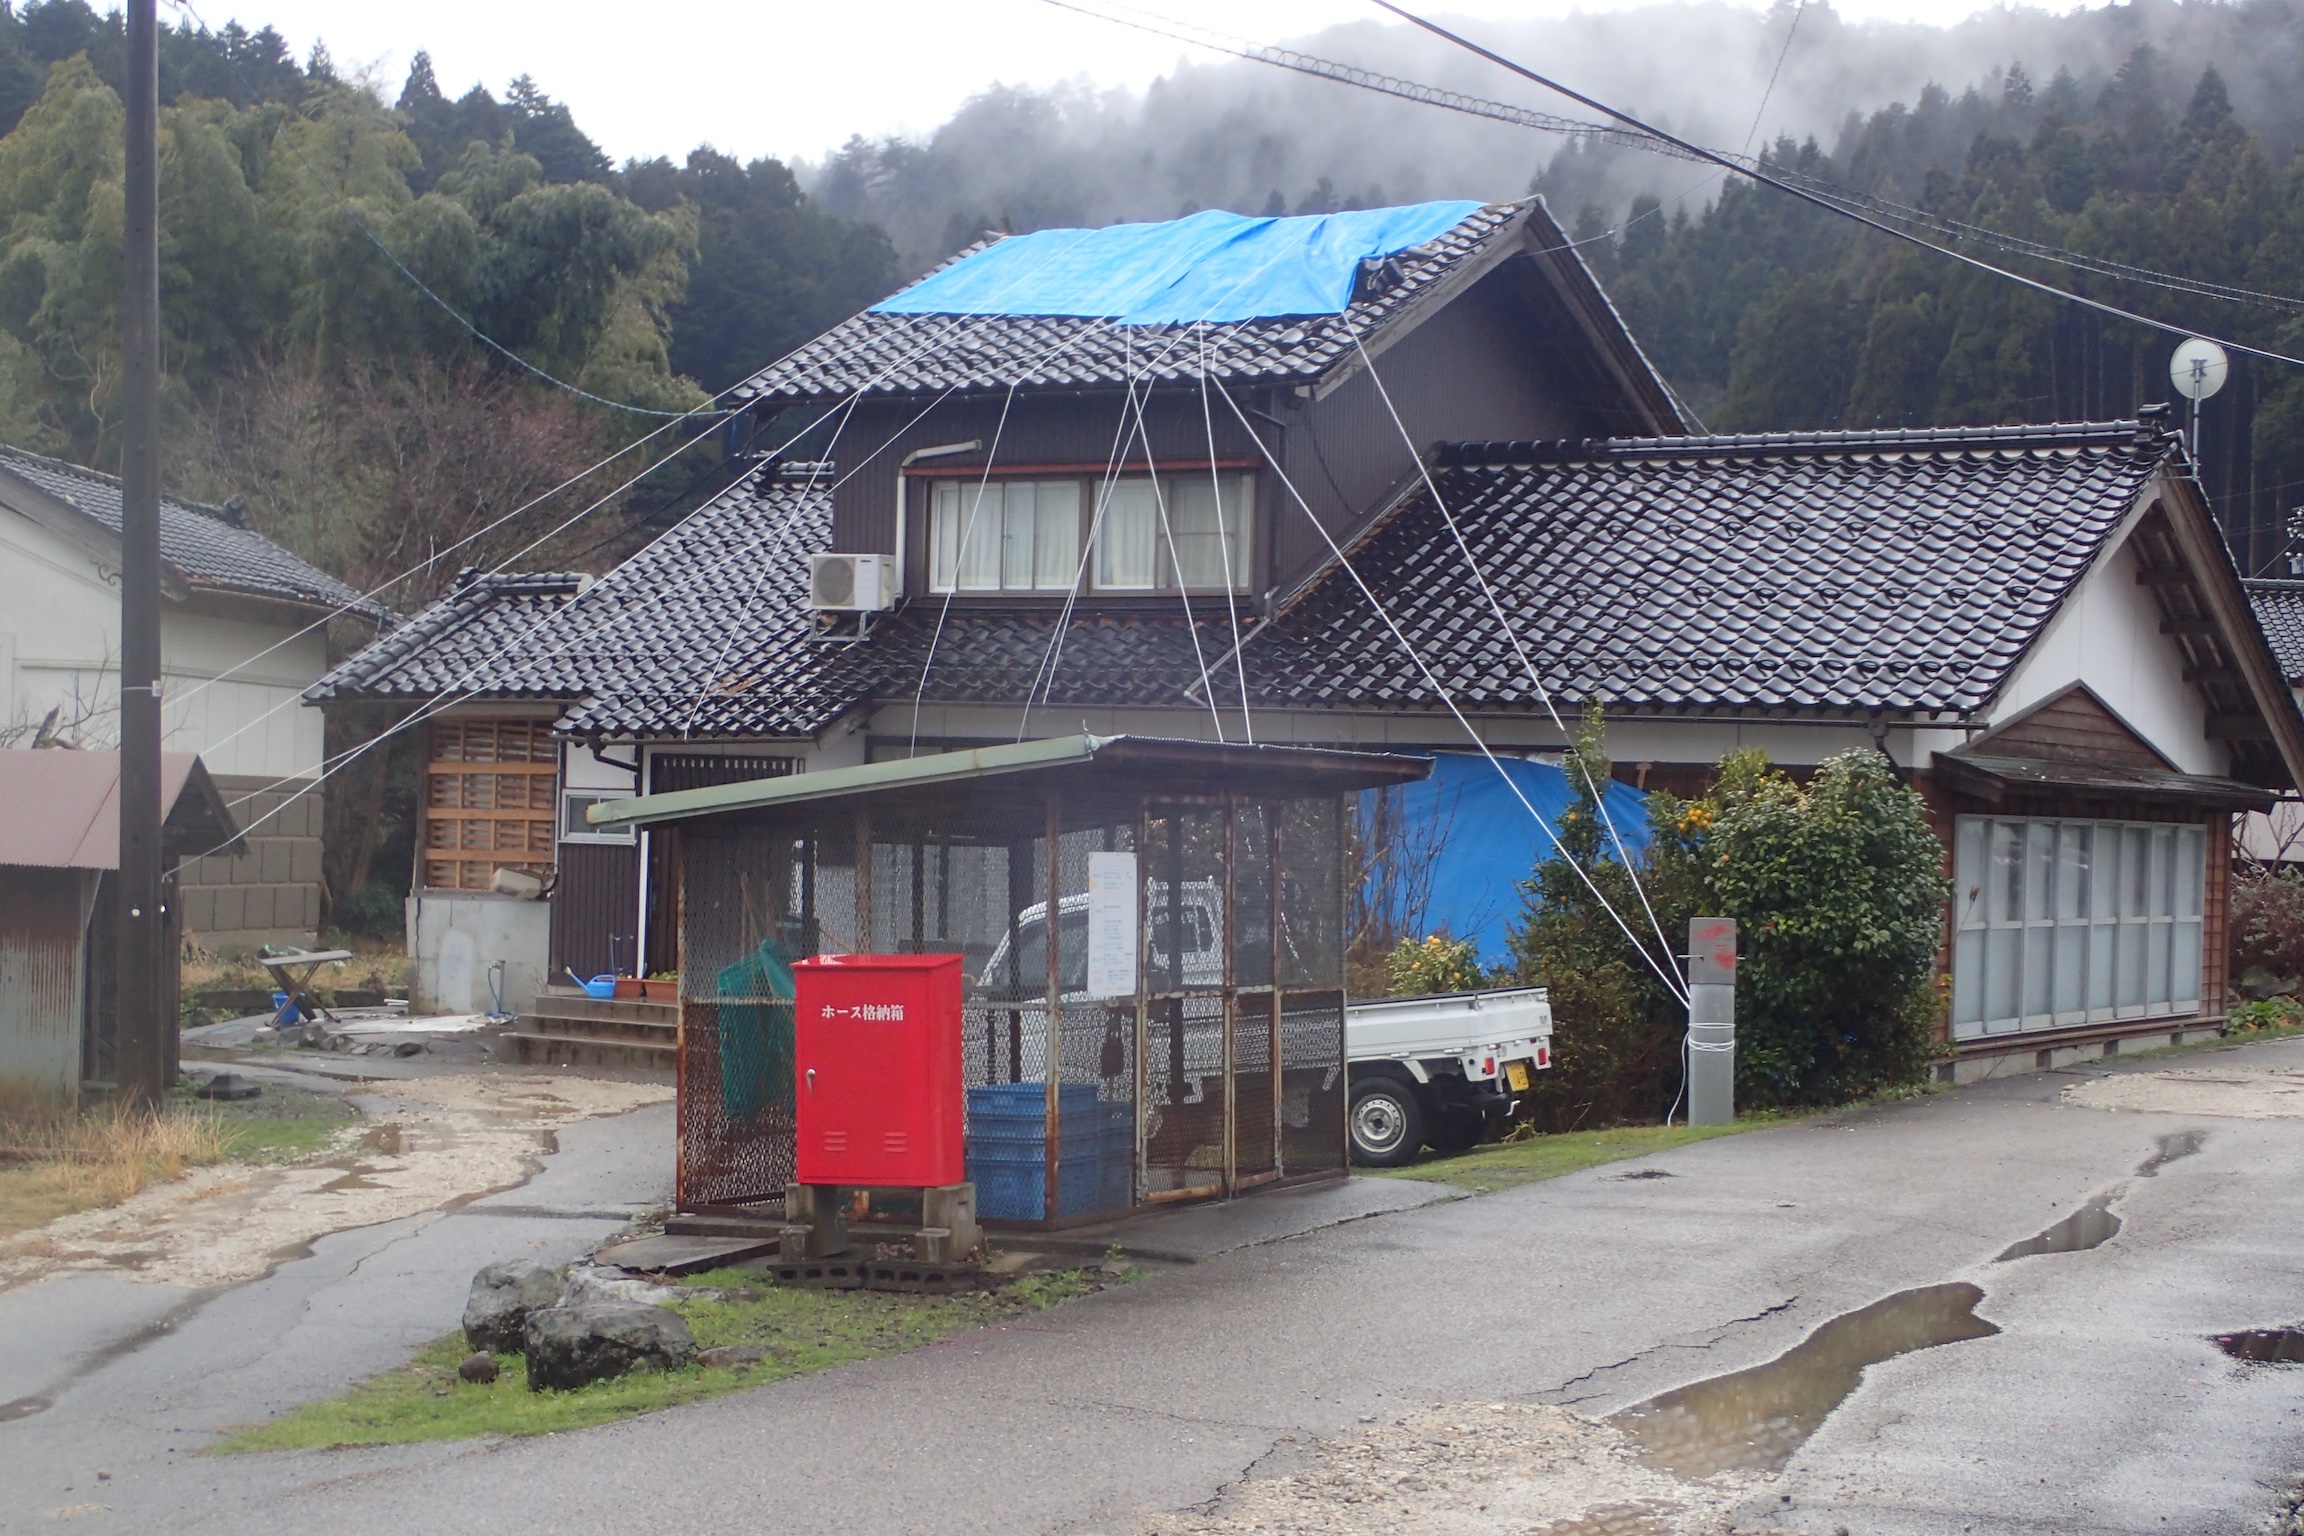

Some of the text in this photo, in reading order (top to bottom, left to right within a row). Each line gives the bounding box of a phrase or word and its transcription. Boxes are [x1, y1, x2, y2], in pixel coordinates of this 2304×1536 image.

[821, 1003, 904, 1021] ホース格納箱
